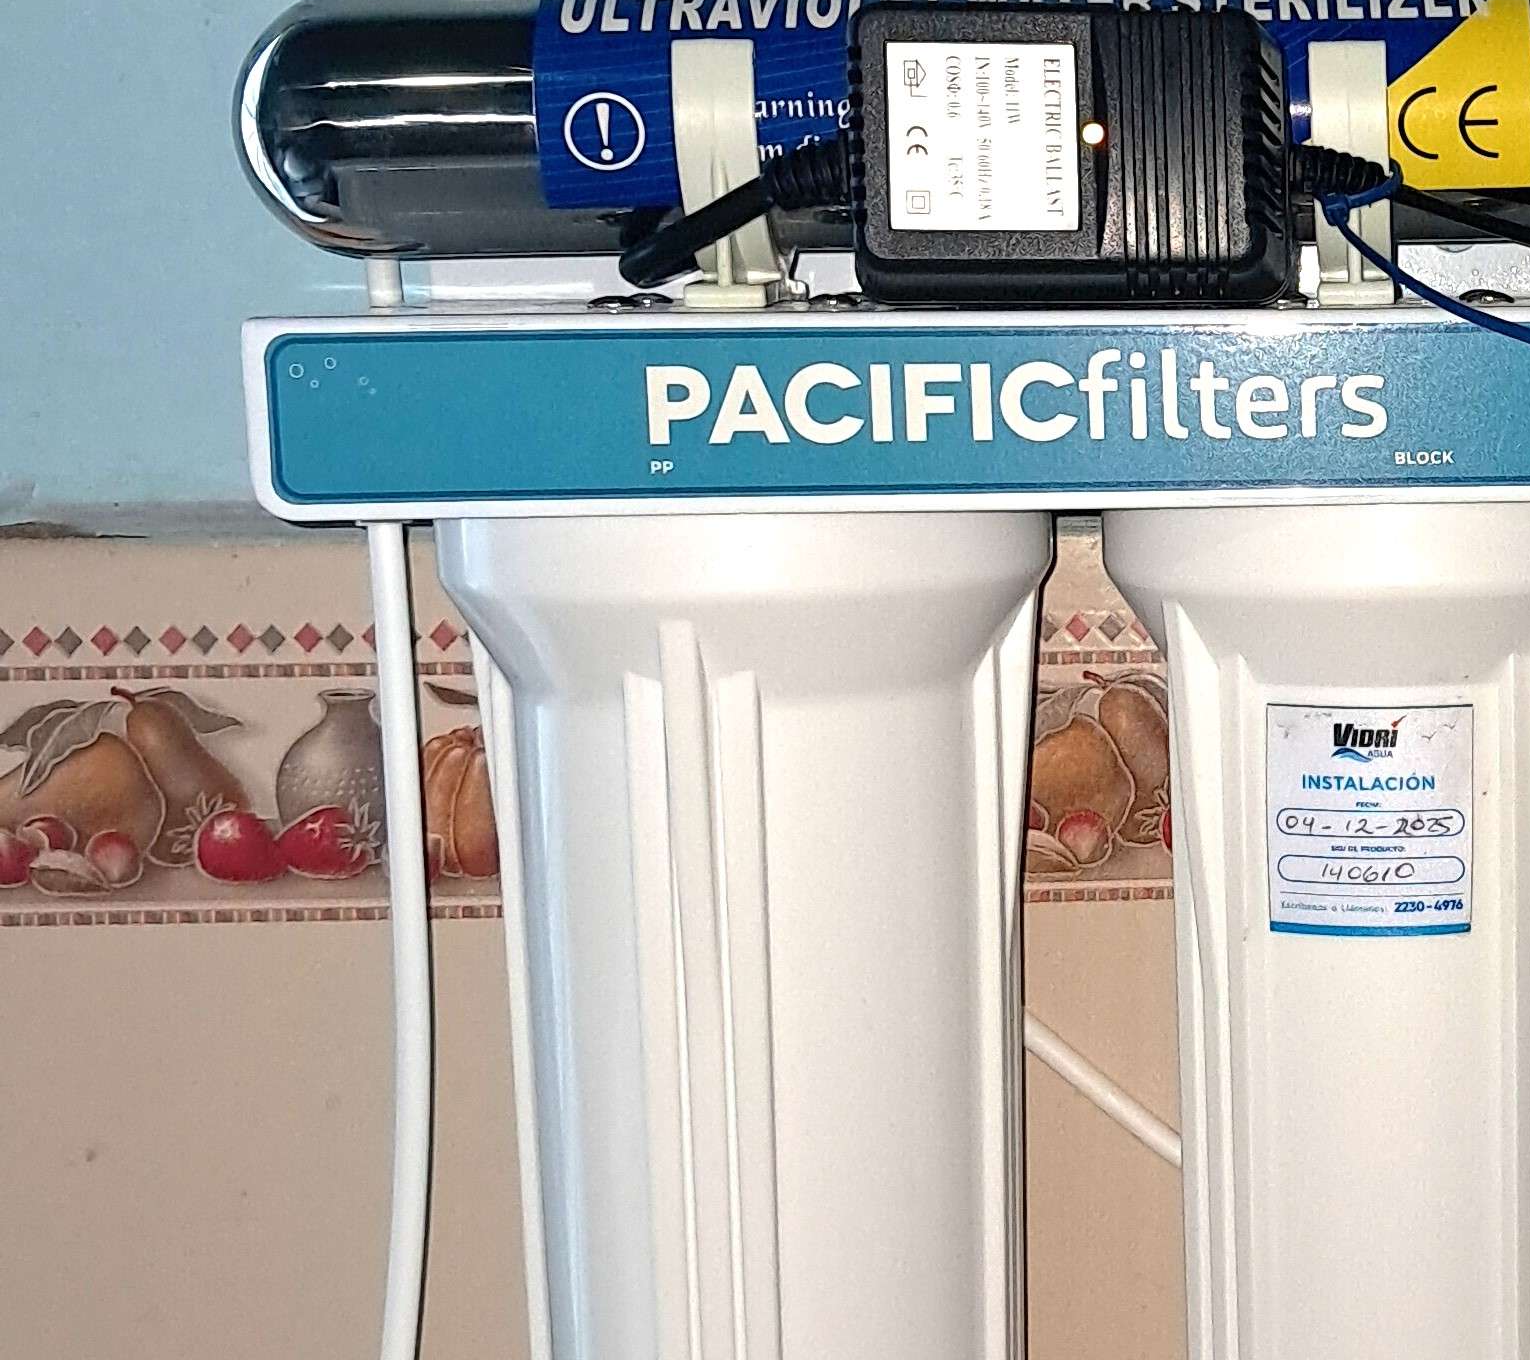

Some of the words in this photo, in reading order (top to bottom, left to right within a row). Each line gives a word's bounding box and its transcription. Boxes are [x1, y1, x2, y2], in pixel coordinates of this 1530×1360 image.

[754, 90, 851, 129] arning
[1044, 58, 1062, 139] ELECTRIC
[1046, 143, 1065, 217] BALLAST
[644, 348, 1388, 445] PACIFICfilters
[650, 460, 674, 474] PP
[1394, 450, 1455, 465] BLOCK
[1302, 772, 1436, 790] INSTALACIÓN
[1394, 899, 1464, 913] 2230-4976
